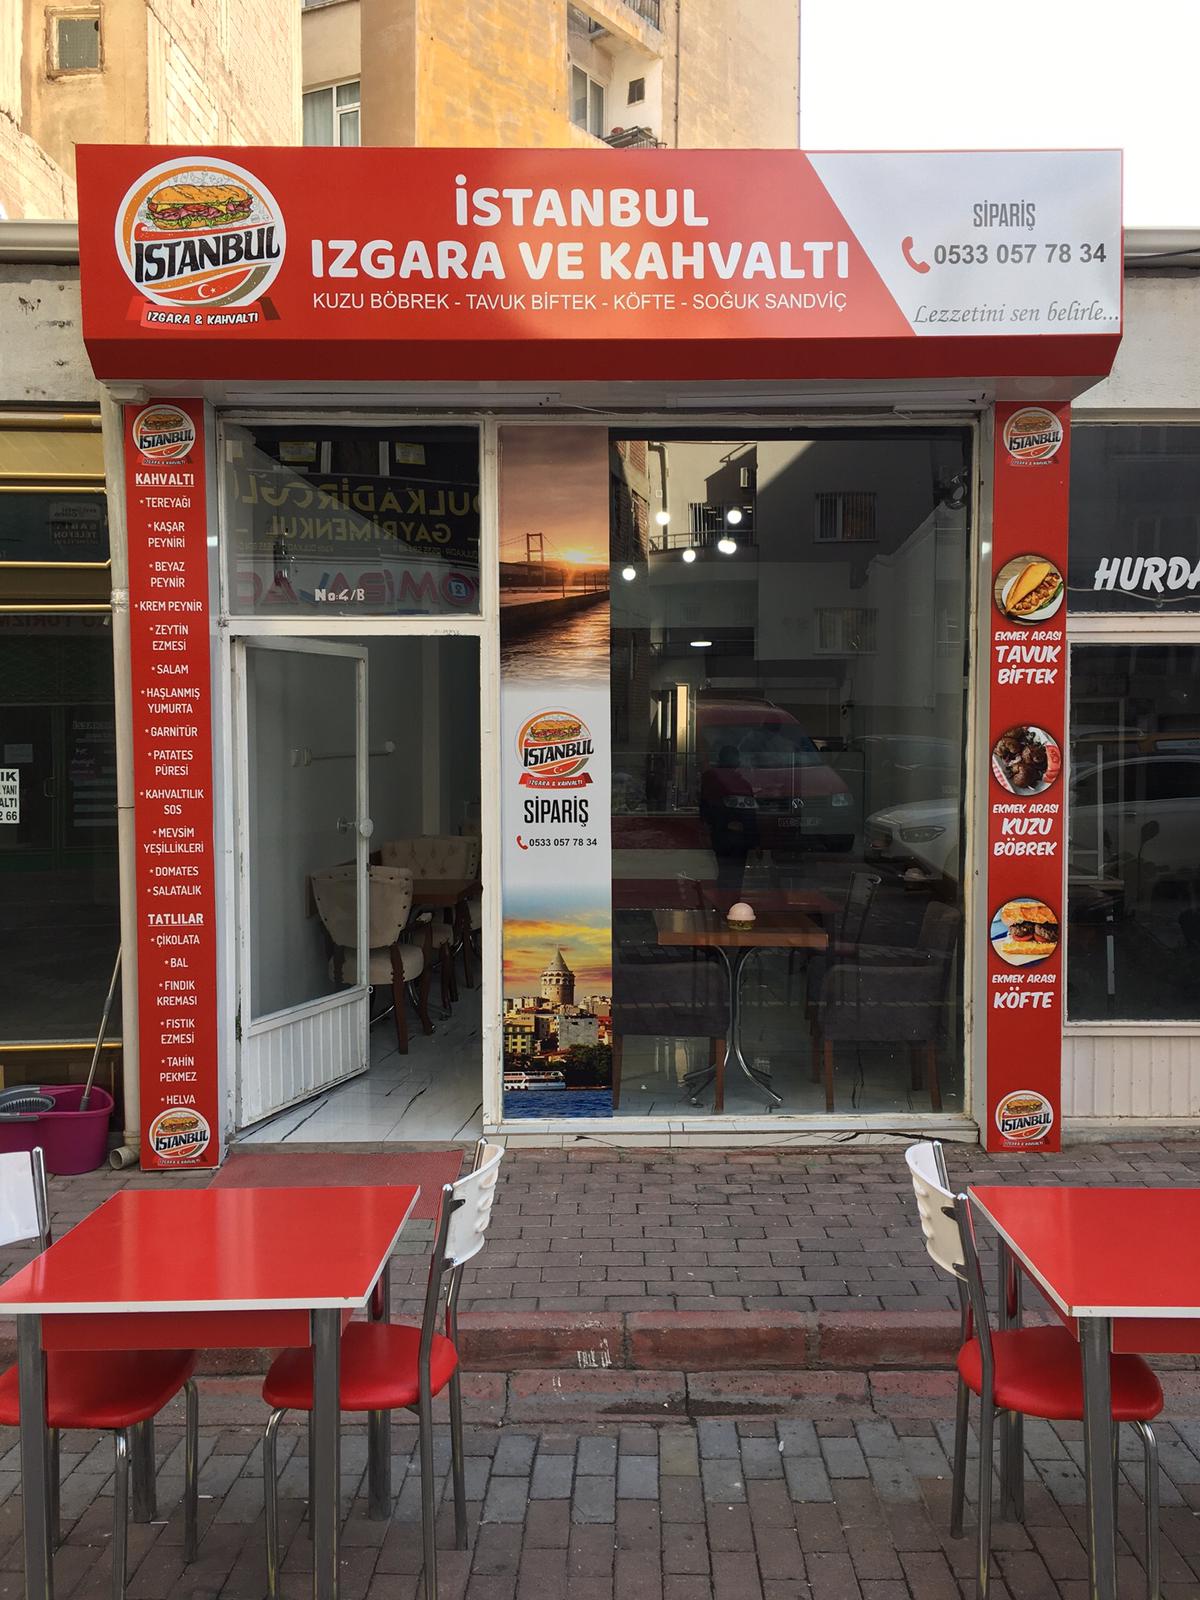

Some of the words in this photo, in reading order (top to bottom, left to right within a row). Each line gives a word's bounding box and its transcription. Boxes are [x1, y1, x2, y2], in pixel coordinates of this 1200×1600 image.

[455, 174, 709, 227] İSTANBUL
[973, 200, 1036, 231] SİPARİŞ
[311, 239, 506, 280] IZGARA
[518, 241, 585, 280] VE
[600, 240, 849, 280] KAHVALTI
[934, 245, 988, 264] 0533
[996, 244, 1037, 264] 057
[1045, 243, 1072, 263] 78
[1079, 243, 1107, 262] 34
[313, 292, 364, 309] KUZU
[373, 290, 449, 309] BÖBREK
[466, 293, 526, 310] TAVUK
[533, 291, 597, 310] BİFTEK
[614, 289, 676, 310] KÖFTE
[693, 290, 760, 310] SOĞUK
[765, 289, 848, 312] SANDVİÇ
[147, 311, 190, 325] IZGARA
[195, 315, 203, 325] &
[207, 312, 259, 325] KAHVALTI
[914, 303, 1007, 323] Lezzetini
[1010, 308, 1040, 321] sen
[1047, 301, 1119, 321] belirle...
[135, 473, 195, 485] KAHVALTI
[145, 495, 191, 508] TEREYAĞI
[153, 522, 185, 535] KAŞAR
[148, 536, 186, 548] PEYNİRİ
[155, 562, 185, 572] BEYAZ
[150, 576, 185, 588] PEYNİR
[140, 601, 167, 611] KREM
[168, 599, 203, 611] PEYNİR
[155, 623, 189, 635] ZEYTİN
[994, 631, 1027, 641] EKMEK
[1031, 631, 1062, 641] ARASI
[152, 639, 187, 651] EZMESİ
[995, 645, 1061, 664] TAVUK
[156, 664, 189, 674] SALAM
[998, 664, 1058, 685] BİFTEK
[146, 688, 201, 700] HAŞLANMIŞ
[148, 703, 193, 714] YUMURTA
[150, 724, 198, 737] GARNİTÜR
[153, 750, 193, 760] PATATES
[155, 764, 189, 776] PÜRESİ
[145, 789, 204, 799] KAHVALTILIK
[163, 804, 182, 815] SOS
[524, 795, 589, 827] SİPARİŞ
[993, 804, 1026, 814] EKMEK
[1029, 803, 1059, 814] ARASI
[6, 811, 17, 820] 66
[158, 825, 195, 837] MEVSİM
[1001, 817, 1053, 836] KUZU
[143, 841, 204, 855] YEŞİLLİKLERİ
[529, 838, 551, 846] 0533
[554, 838, 570, 846] 057
[573, 838, 584, 846] 78
[586, 838, 598, 846] 34
[993, 837, 1058, 857] BÖBREK
[155, 866, 199, 876] DOMATES
[152, 885, 202, 896] SALATALIK
[147, 913, 204, 925] TATLILAR
[156, 933, 200, 947] ÇİKOLATA
[170, 957, 189, 968] BAL
[992, 974, 1025, 984] EKMEK
[1029, 974, 1056, 984] ARASI
[164, 981, 195, 990] FINDIK
[156, 995, 198, 1006] KREMASI
[993, 986, 1053, 1009] KÖFTE
[166, 1018, 195, 1028] FISTIK
[161, 1032, 195, 1044] EZMESİ
[167, 1054, 195, 1066] TAHİN
[160, 1071, 197, 1082] PEKMEZ
[166, 1095, 196, 1105] HELVA
